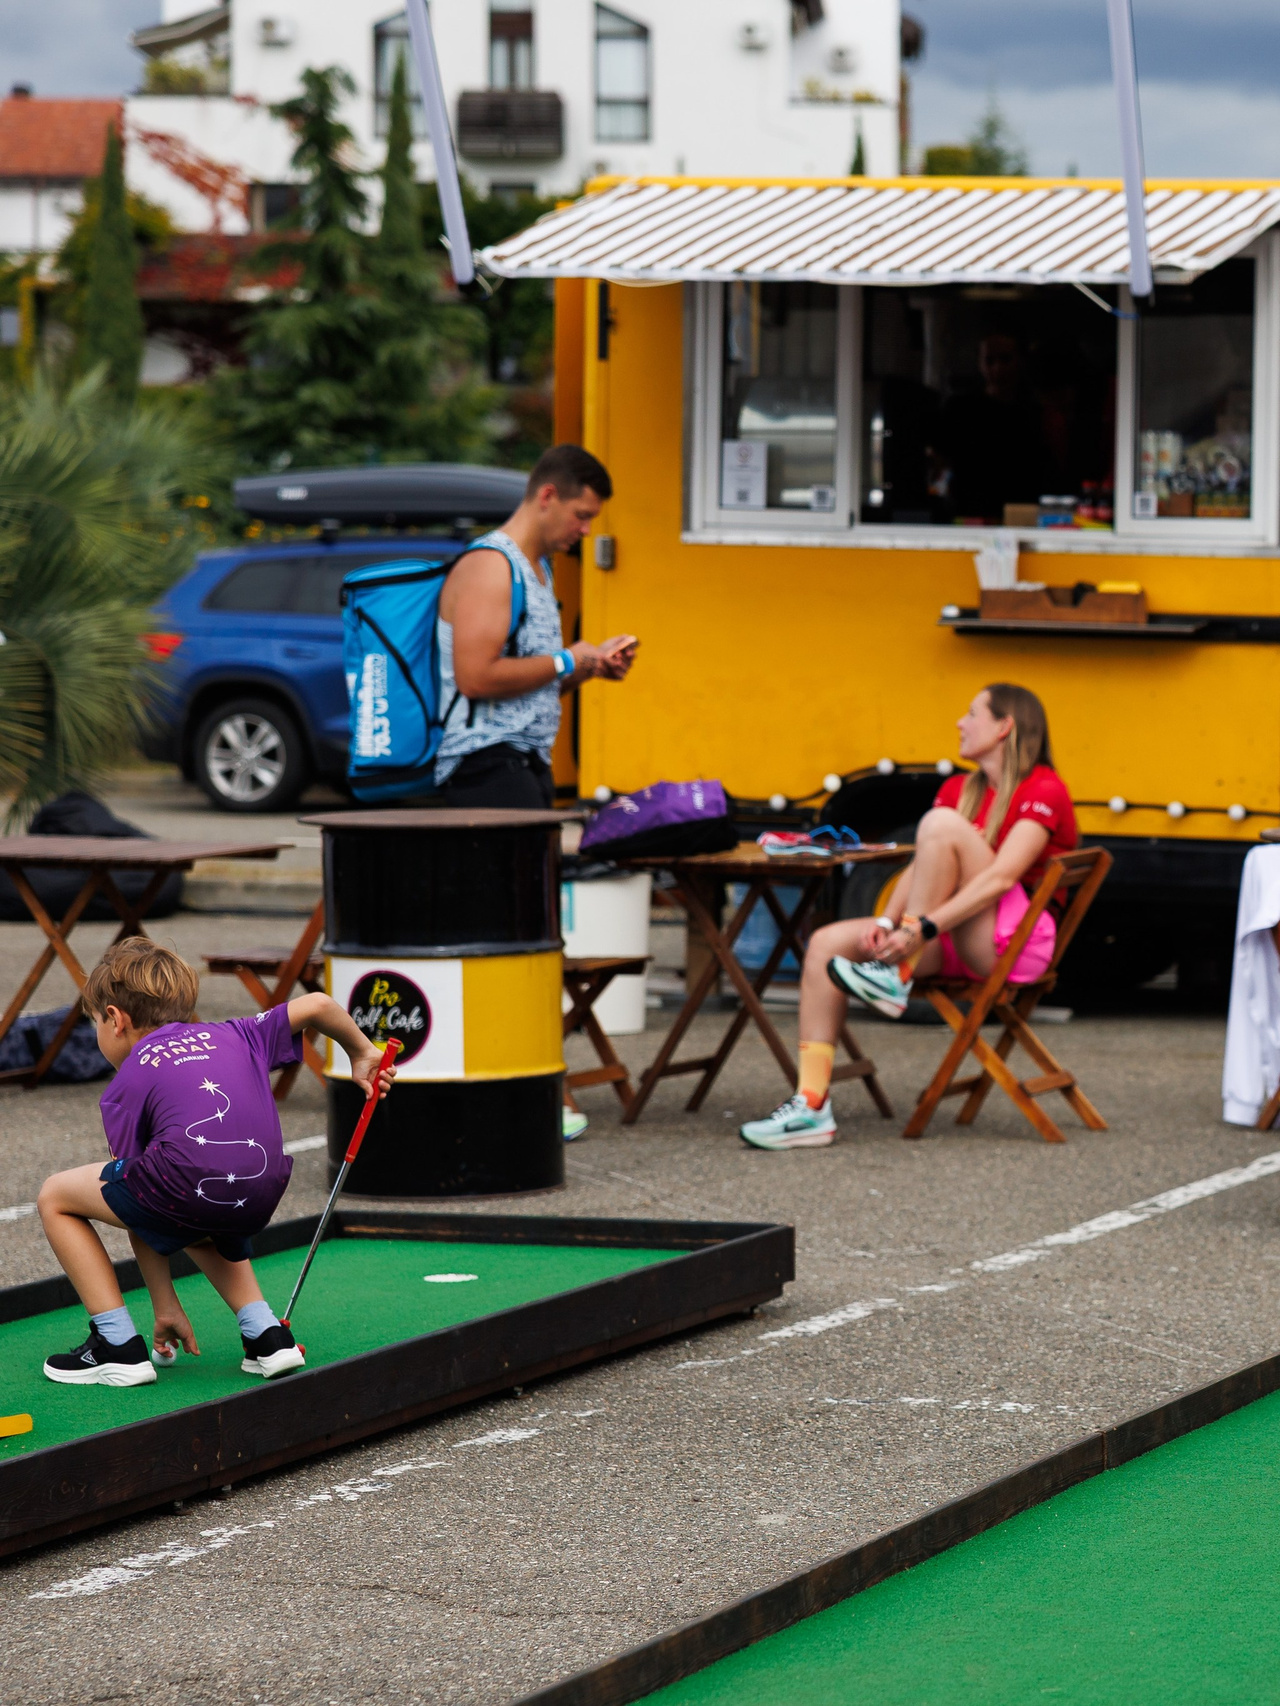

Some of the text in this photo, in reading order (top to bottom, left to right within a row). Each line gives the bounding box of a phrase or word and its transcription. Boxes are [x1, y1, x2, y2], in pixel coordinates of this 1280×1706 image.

[368, 977, 400, 1007] Pro
[386, 1006, 425, 1033] Cafe
[139, 1031, 212, 1065] GRAND
[150, 1042, 218, 1068] FINAL
[173, 1054, 211, 1066] STARKIDS
